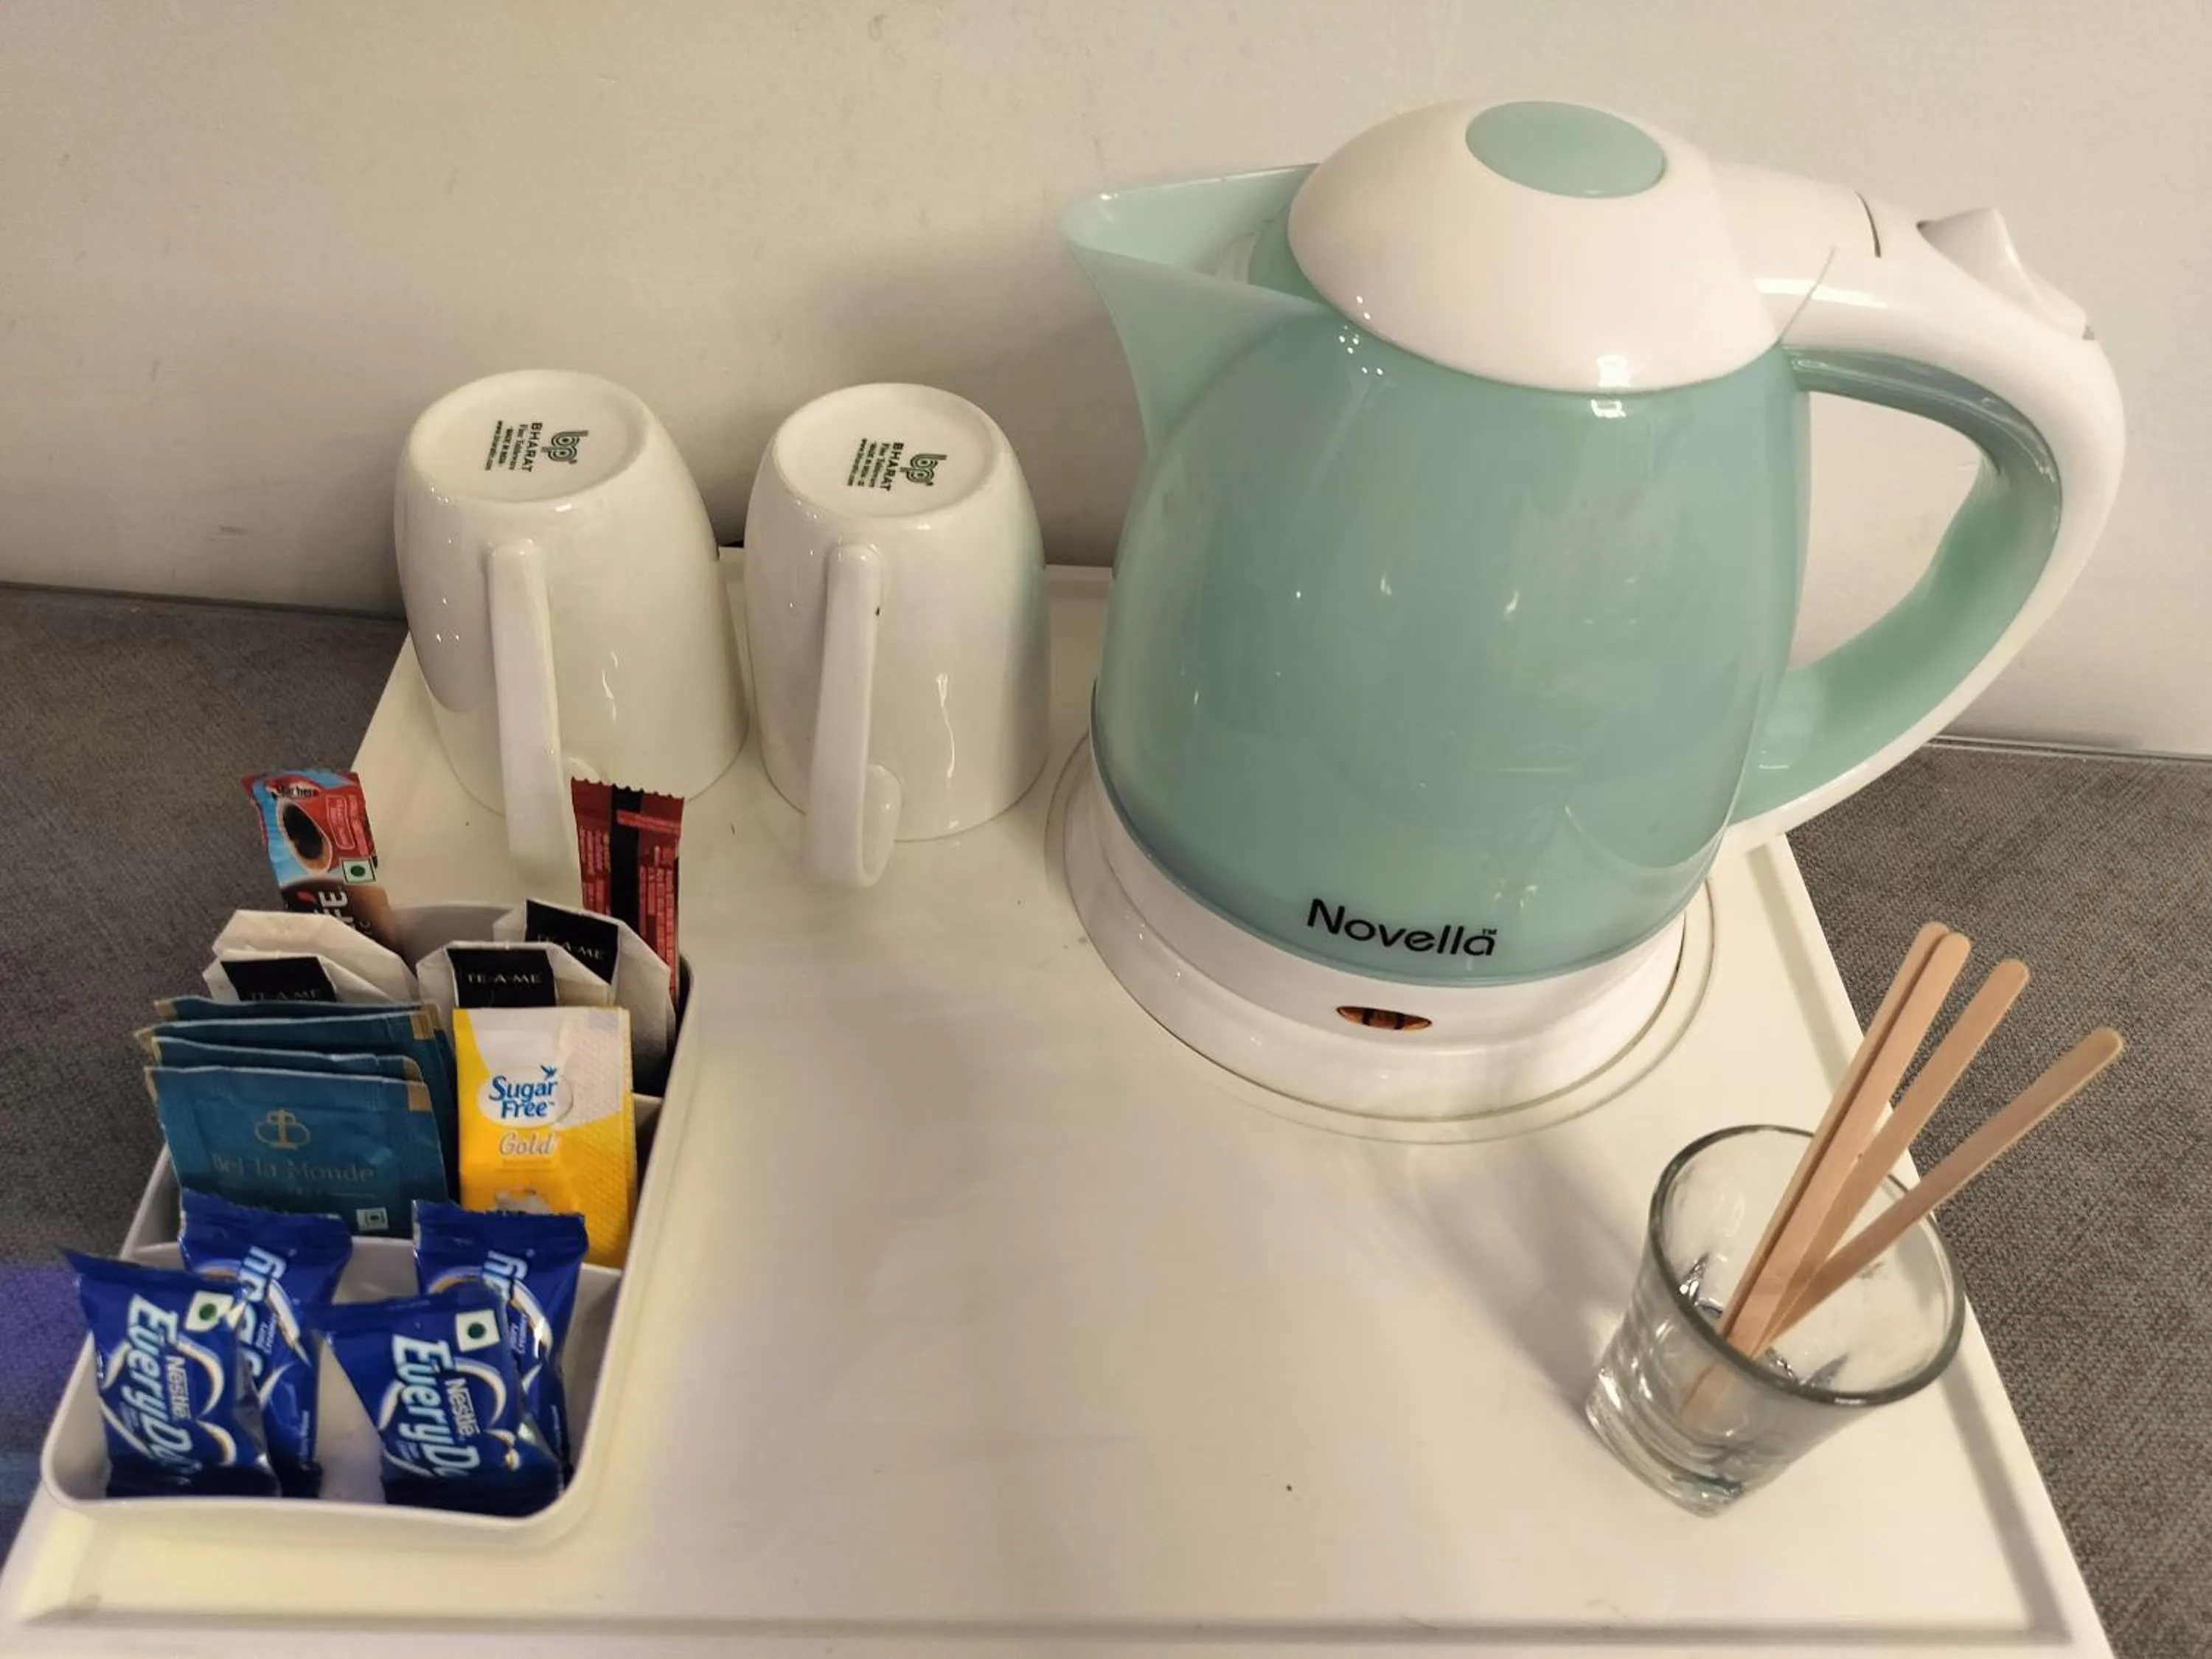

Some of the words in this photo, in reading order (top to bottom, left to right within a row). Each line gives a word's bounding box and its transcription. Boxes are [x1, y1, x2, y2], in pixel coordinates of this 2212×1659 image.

[521, 422, 543, 472] BHARAT
[880, 442, 904, 491] BHARAT
[1307, 897, 1497, 956] Novella
[488, 1074, 559, 1104] Sugar
[500, 1097, 548, 1119] Free
[498, 1132, 555, 1156] Gold
[288, 1158, 374, 1183] Monde
